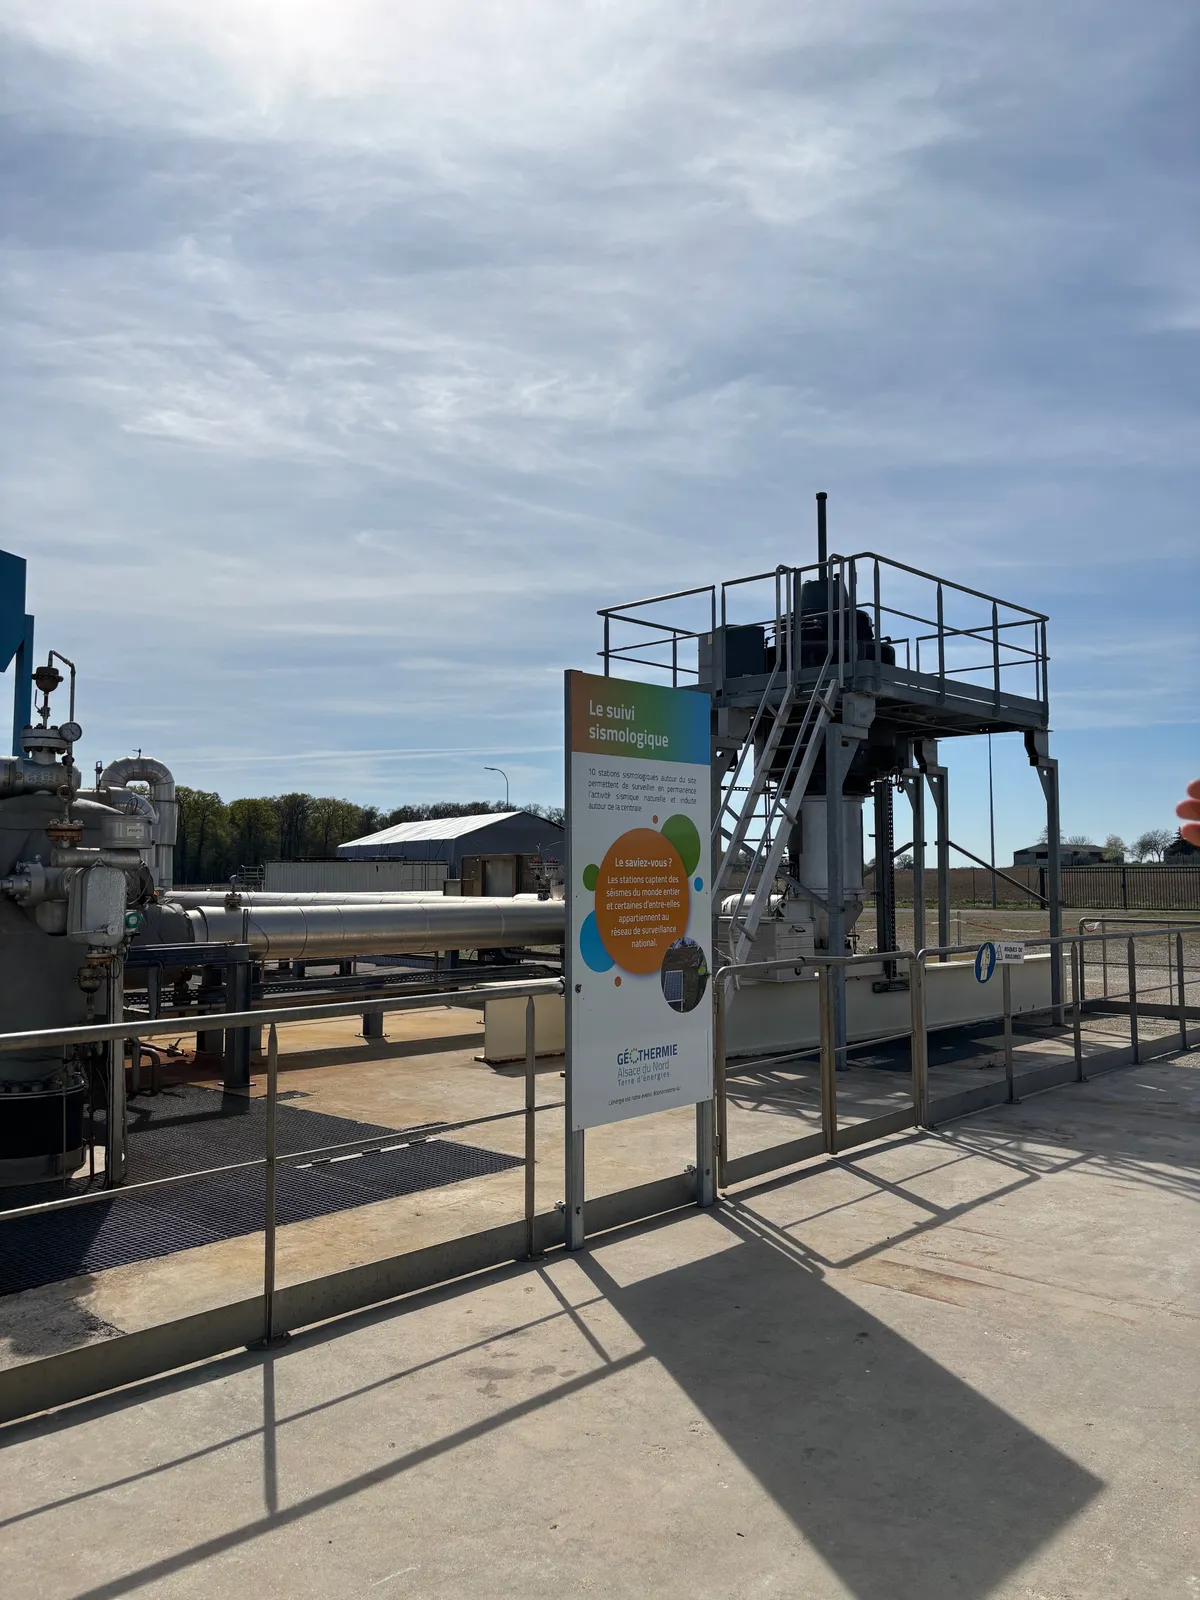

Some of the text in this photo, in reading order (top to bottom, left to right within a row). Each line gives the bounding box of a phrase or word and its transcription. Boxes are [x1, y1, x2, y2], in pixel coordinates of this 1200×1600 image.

[589, 700, 635, 720] Le suivi
[589, 724, 668, 749] sismologique
[623, 771, 659, 782] sismologiques
[588, 781, 619, 789] permettent
[632, 783, 654, 791] surveiller
[616, 793, 639, 802] sismique
[615, 858, 672, 867] Le saviez-vous ?
[646, 877, 667, 885] captent
[606, 888, 631, 897] séismes
[619, 914, 660, 924] appartiennent
[611, 928, 632, 936] réseau
[642, 926, 676, 934] surveillance
[632, 939, 657, 947] national.
[617, 1044, 678, 1065] GÉOTHERMIE
[617, 1061, 669, 1078] Alsace du Nord
[618, 1071, 670, 1086] Terre d'énergies
